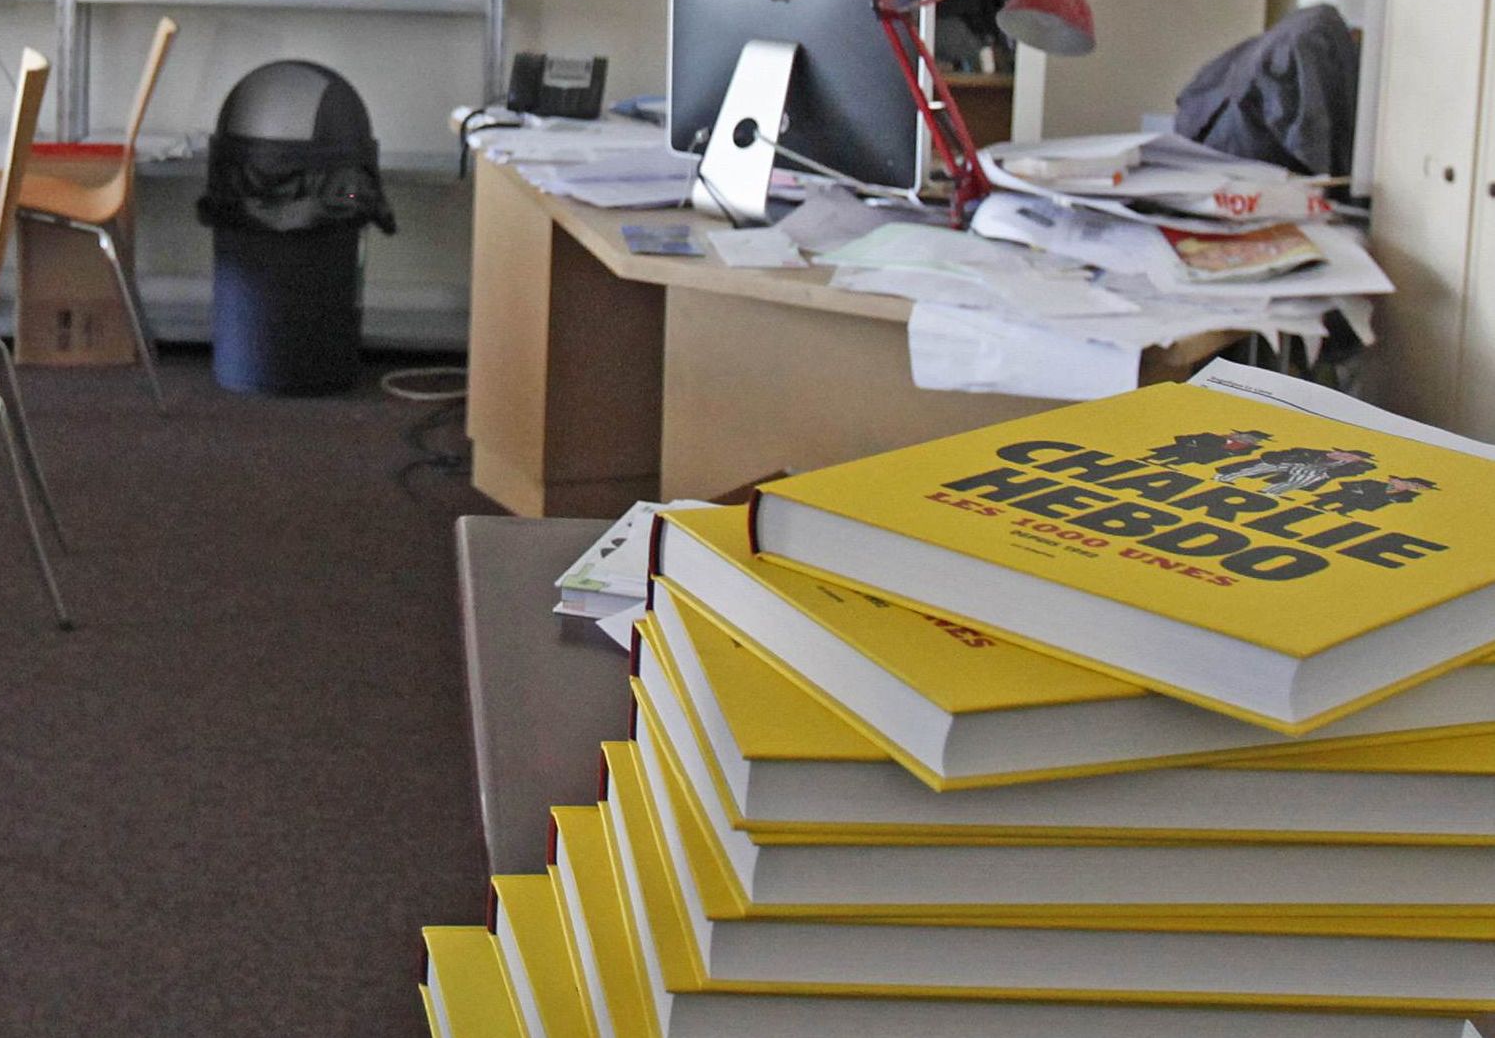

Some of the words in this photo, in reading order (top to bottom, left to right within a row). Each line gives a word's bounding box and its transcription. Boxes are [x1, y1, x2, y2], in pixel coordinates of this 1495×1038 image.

[924, 491, 1004, 517] LES
[1011, 517, 1110, 548] 1000
[1118, 547, 1240, 587] UNES
[941, 467, 1330, 581] HEBDO
[996, 440, 1450, 569] CHARLIE
